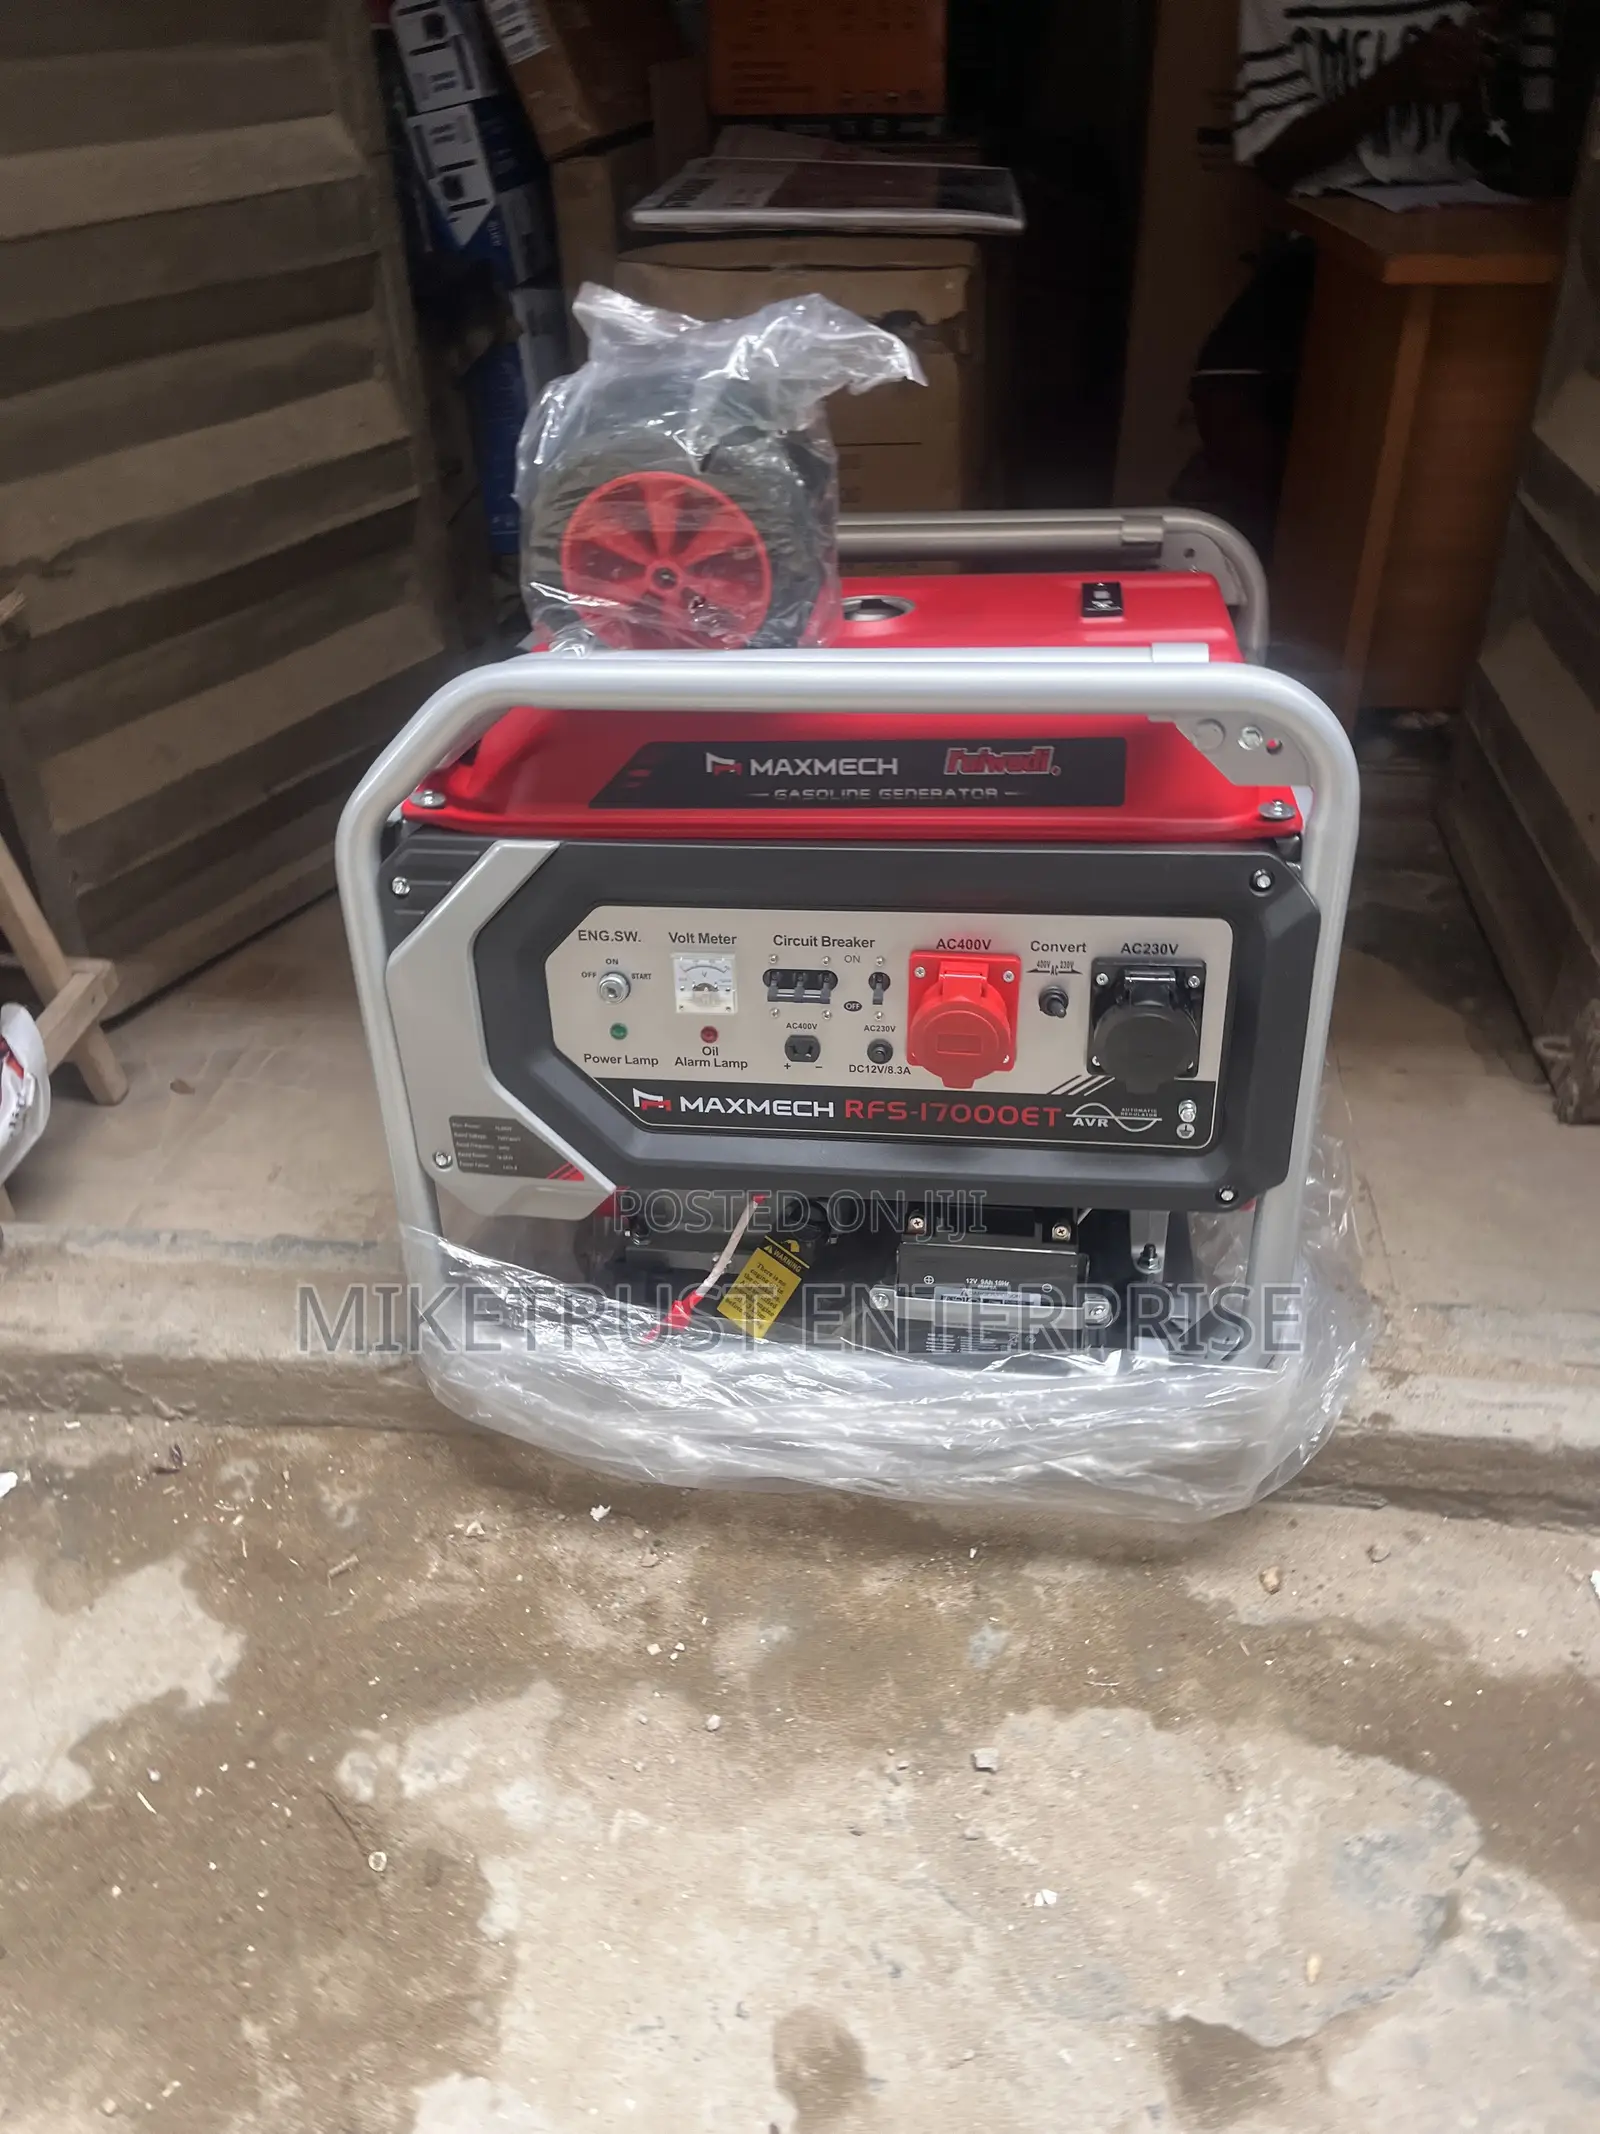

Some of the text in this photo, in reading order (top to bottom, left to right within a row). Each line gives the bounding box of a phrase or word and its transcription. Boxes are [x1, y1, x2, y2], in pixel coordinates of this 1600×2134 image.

[750, 757, 898, 776] MAXMECH
[774, 788, 998, 800] GASOLINE GENERATOR
[578, 929, 642, 943] ENG.SW.
[668, 931, 738, 945] Volt Meter
[773, 934, 876, 949] Circuit Breaker
[936, 938, 992, 951] AC400V
[1030, 940, 1087, 953] Convert
[1121, 942, 1179, 955] AC230V
[843, 954, 861, 963] ON
[581, 971, 597, 979] OFF
[785, 1022, 818, 1030] AC400V
[863, 1025, 896, 1033] AC230V
[702, 1046, 719, 1056] Oil
[583, 1053, 659, 1067] Power Lamp
[674, 1056, 748, 1070] Alarm Lamp
[848, 1064, 912, 1075] DC12V/8.3A
[680, 1096, 834, 1119] MAXMECH
[1072, 1118, 1109, 1128] AVR
[773, 1249, 802, 1273] WARNING
